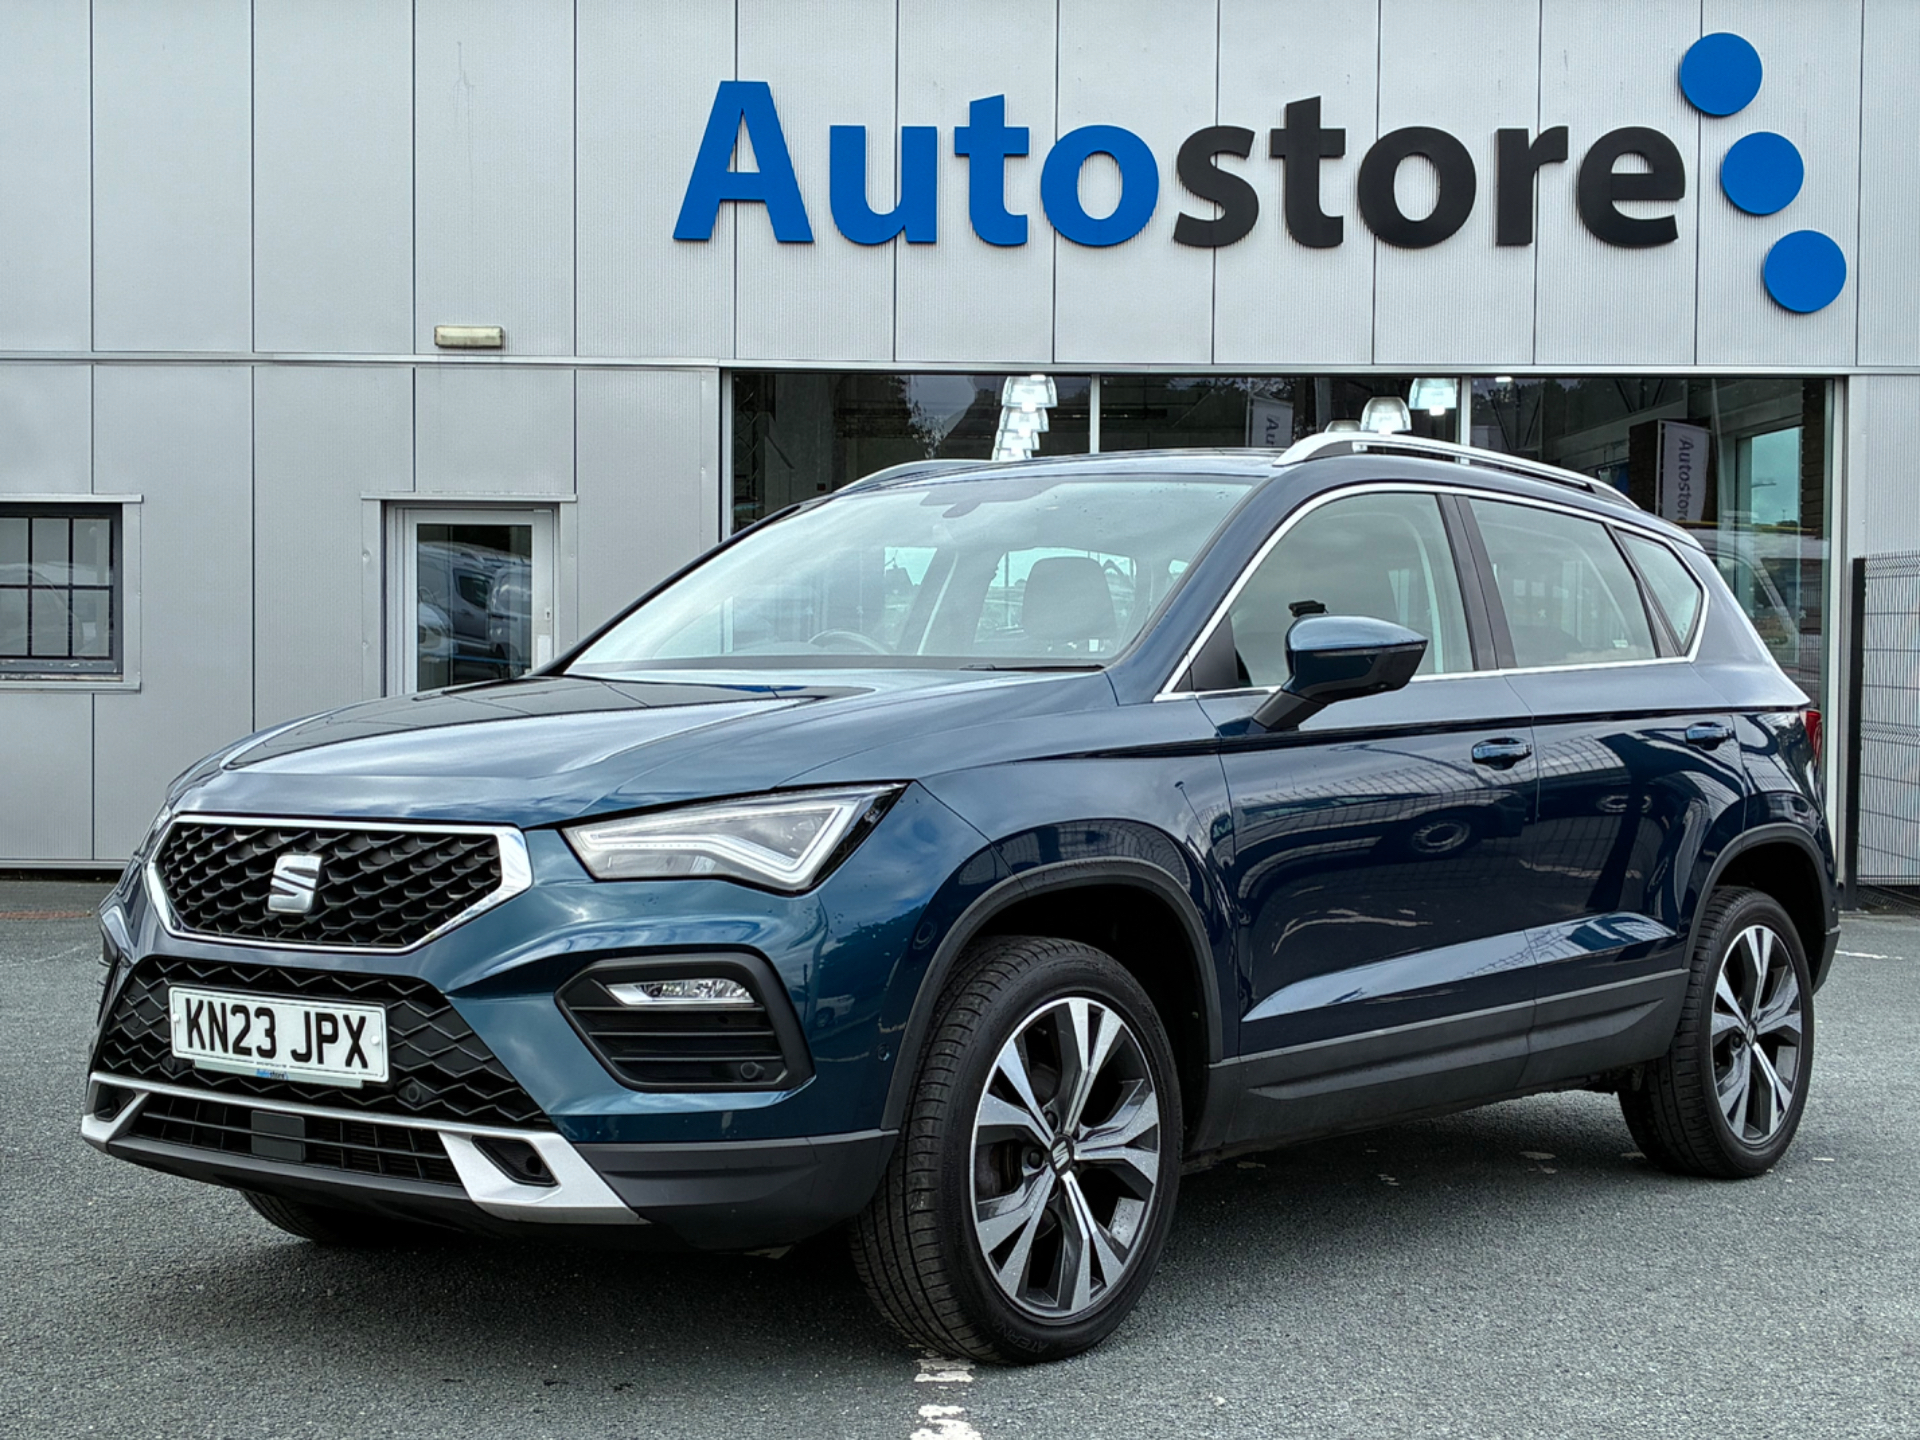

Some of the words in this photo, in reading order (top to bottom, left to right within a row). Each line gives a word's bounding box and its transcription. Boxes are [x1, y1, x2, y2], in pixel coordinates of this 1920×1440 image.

[672, 79, 1687, 249] Autostore
[185, 997, 277, 1060] KN23
[290, 1010, 369, 1070] JPX
